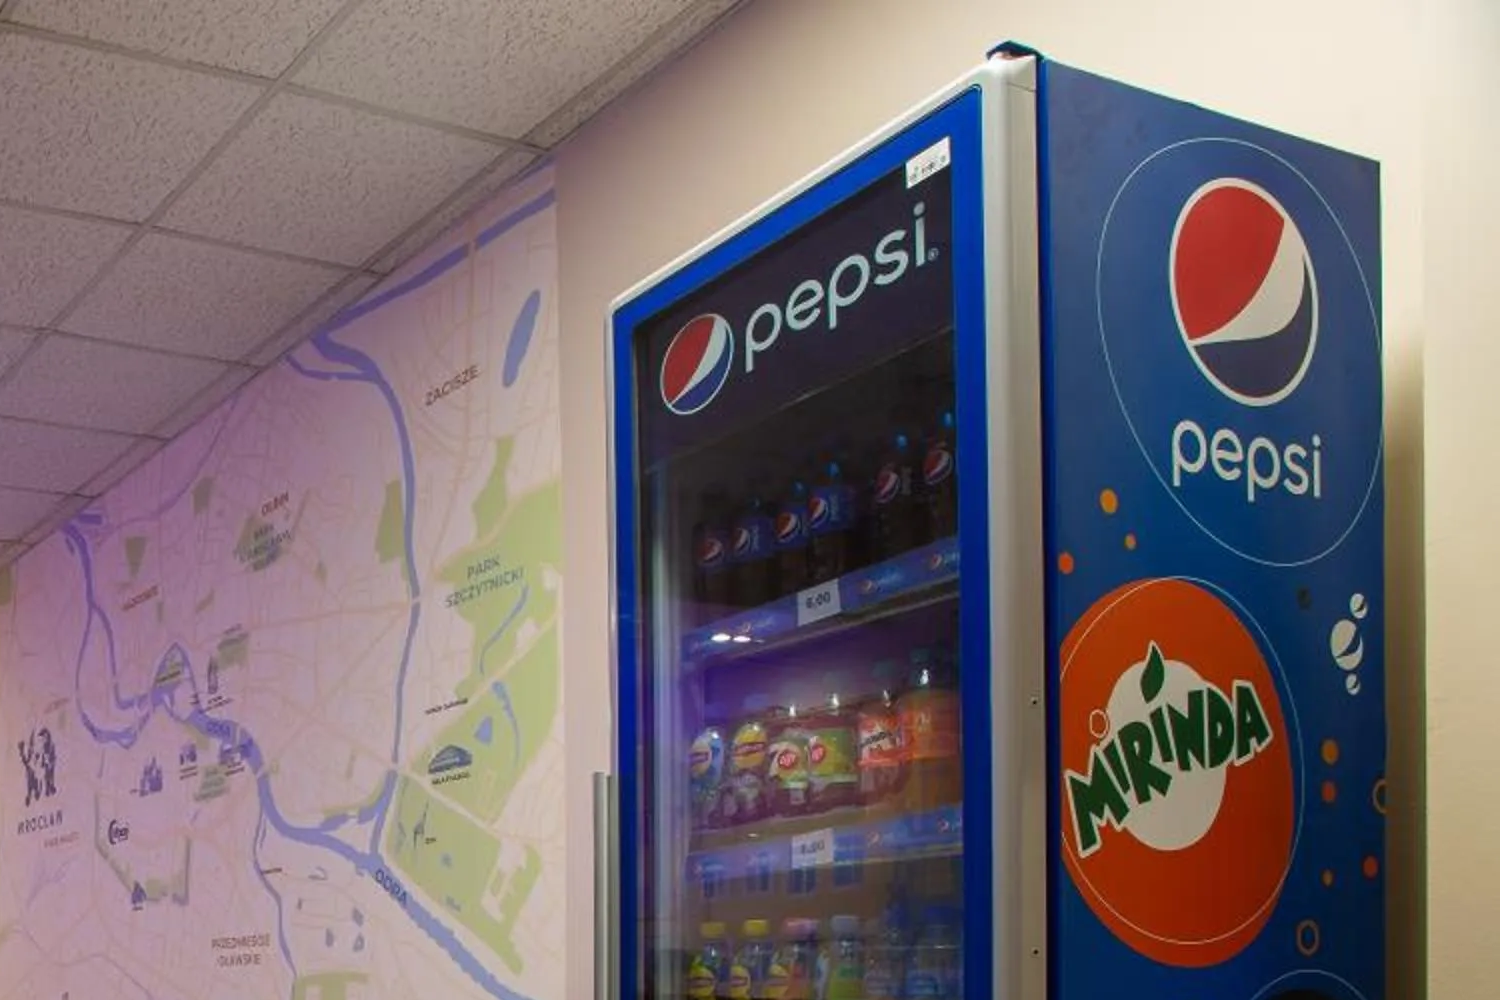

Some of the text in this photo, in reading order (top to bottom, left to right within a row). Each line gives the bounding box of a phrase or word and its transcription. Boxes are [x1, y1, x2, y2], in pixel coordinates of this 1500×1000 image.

[745, 202, 927, 373] pepsi
[424, 364, 480, 406] ZACISZE
[1171, 419, 1321, 502] pepsi
[466, 556, 501, 580] PARK
[1064, 679, 1274, 858] MIRINDA
[374, 867, 409, 906] ODRA
